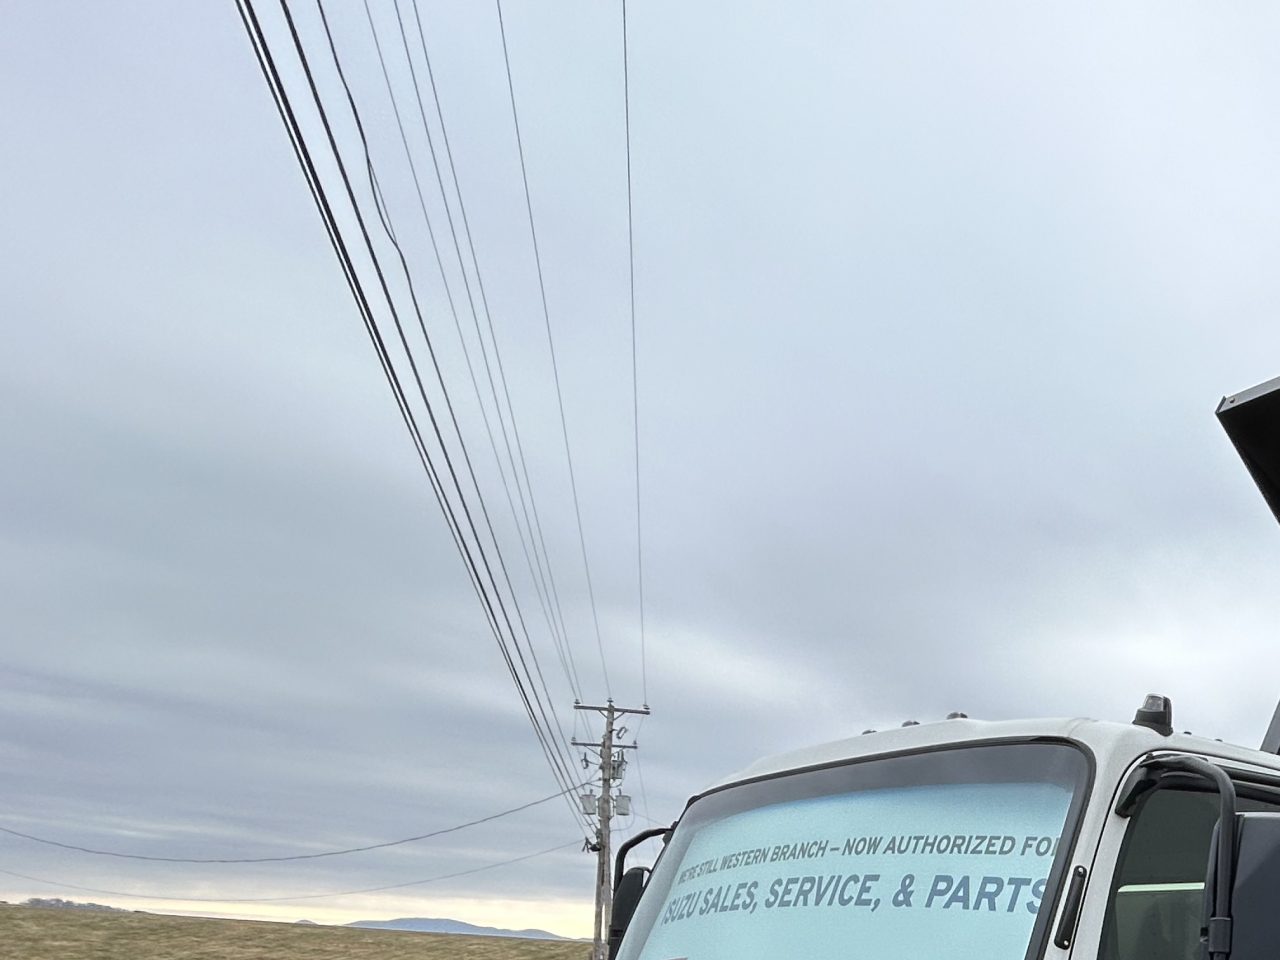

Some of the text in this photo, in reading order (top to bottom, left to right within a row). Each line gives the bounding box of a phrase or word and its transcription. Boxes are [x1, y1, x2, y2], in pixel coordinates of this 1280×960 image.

[697, 858, 718, 877] STILL
[719, 847, 770, 871] WESTERN
[770, 839, 829, 862] BRANCH
[842, 836, 882, 856] NOW
[883, 834, 1016, 856] AUTHORIZED
[661, 892, 701, 925] ISUZU
[699, 881, 759, 916] SALES,
[765, 874, 881, 912] SERVICE,
[892, 873, 915, 908] &
